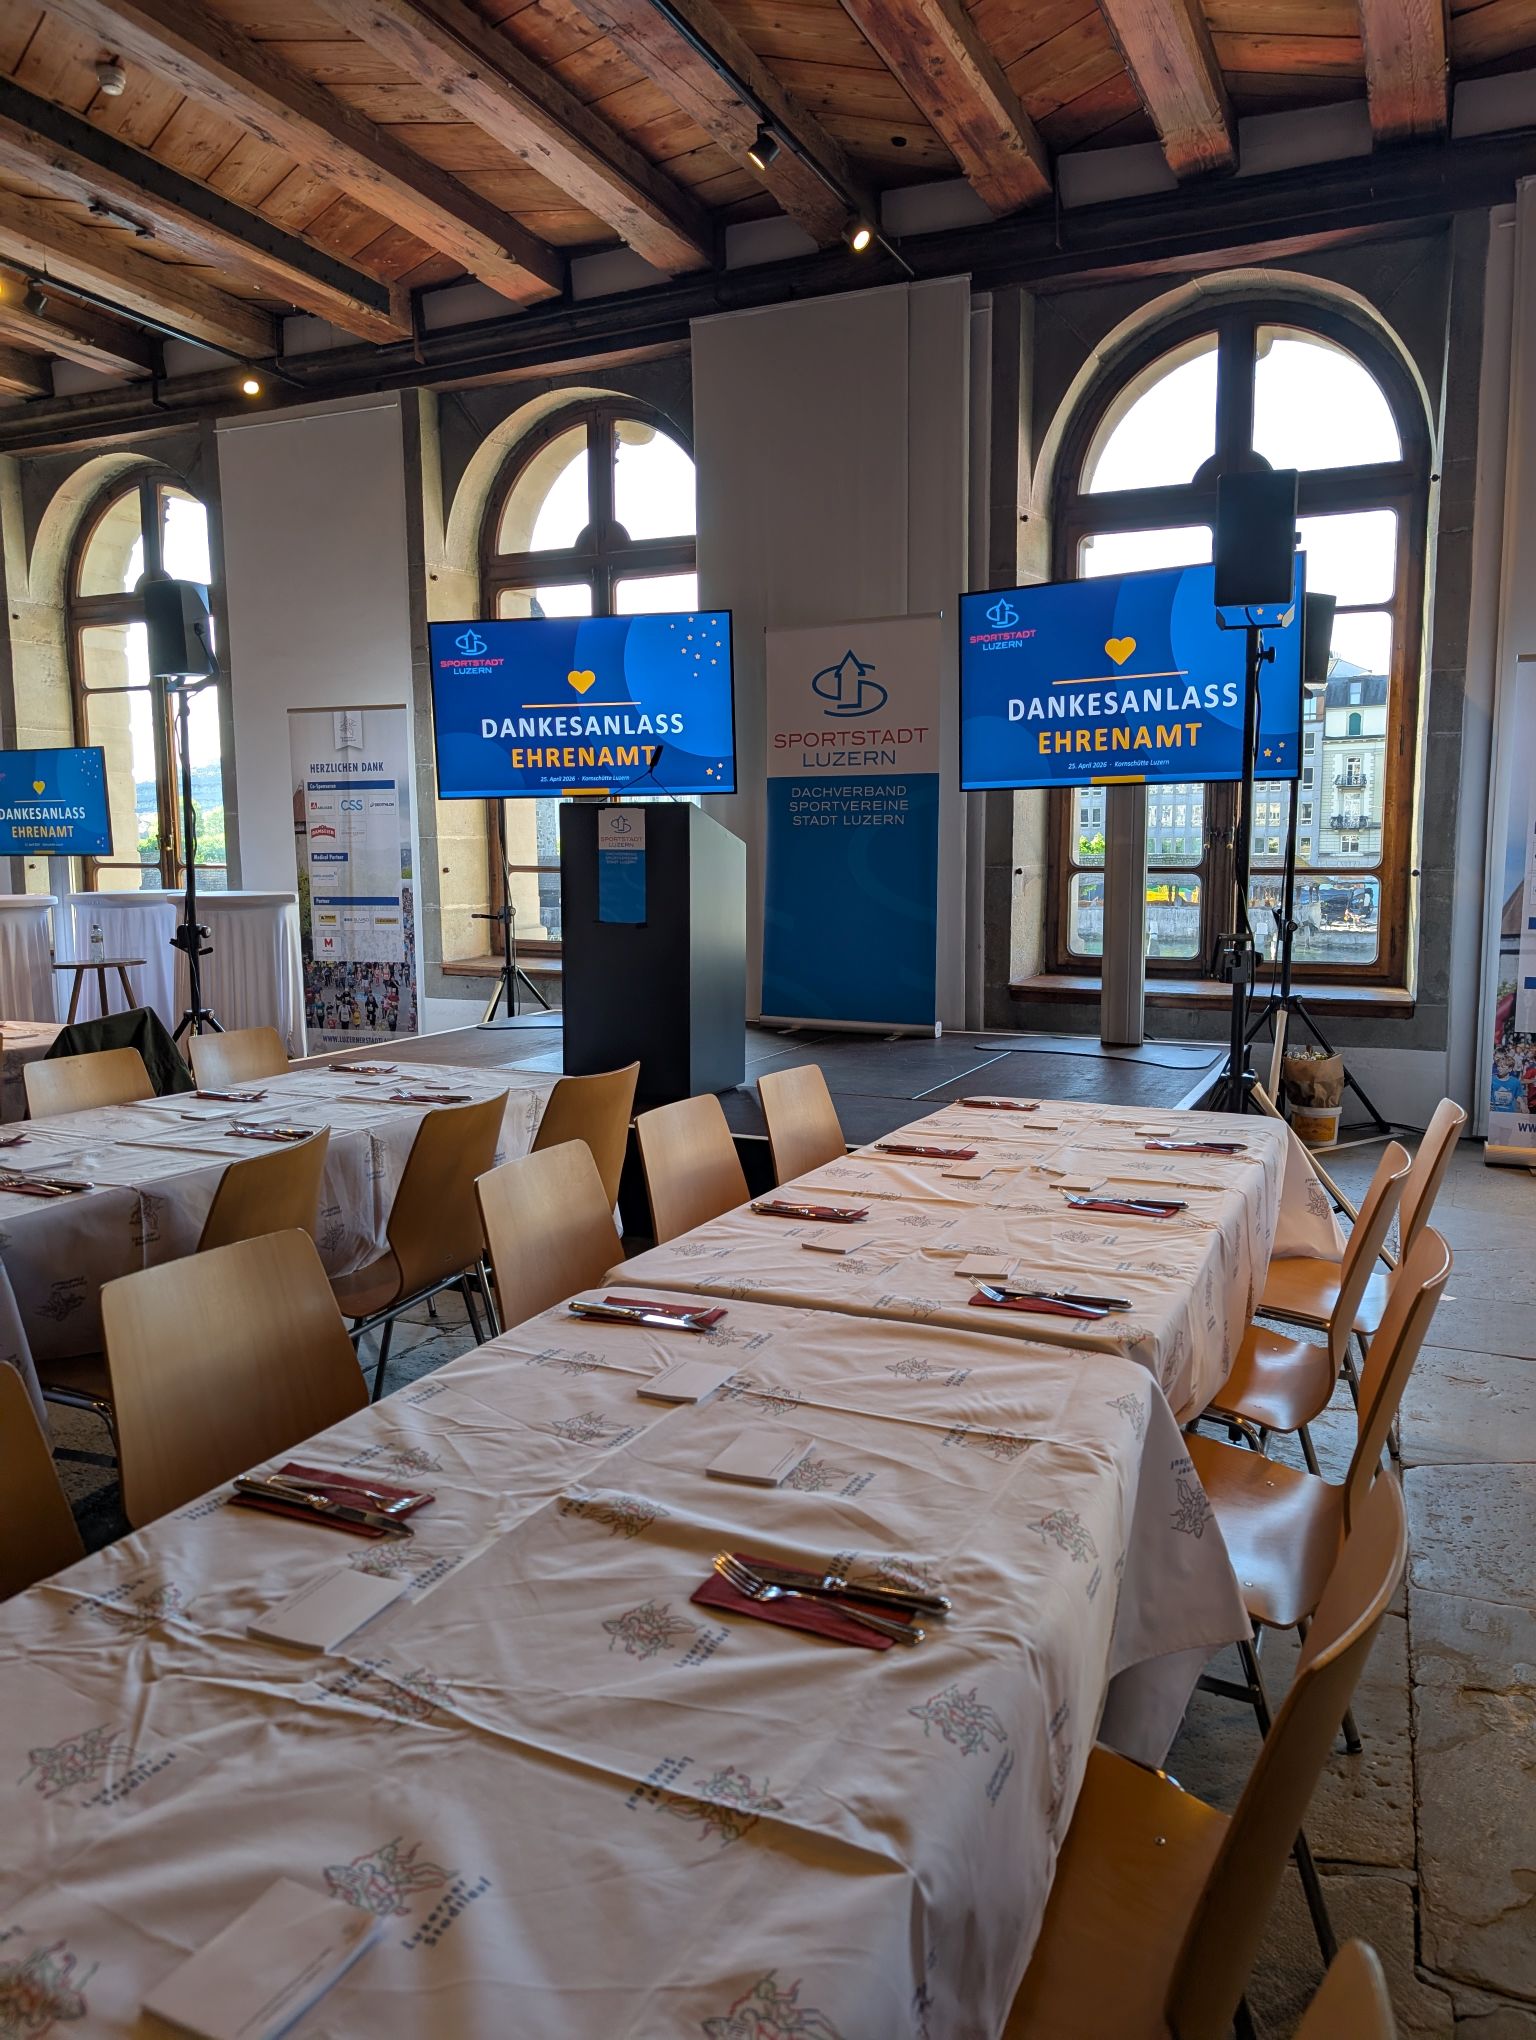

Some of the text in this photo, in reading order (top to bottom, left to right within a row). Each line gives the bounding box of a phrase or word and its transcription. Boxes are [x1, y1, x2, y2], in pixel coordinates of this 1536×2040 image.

[969, 629, 1037, 644] SPORTSTADT
[982, 640, 1023, 651] LUZERN
[440, 658, 504, 668] SPORTSTADT
[453, 667, 493, 675] LUZERN
[1008, 682, 1239, 721] DANKESANLASS
[481, 713, 685, 739] DANKESANLASS
[774, 728, 929, 749] SPORTSTADT
[1038, 722, 1203, 755] EHRENAMT
[511, 745, 656, 769] EHRENAMT
[802, 750, 897, 768] LUZERN
[310, 761, 384, 774] HERZLICHEN DANK
[1078, 762, 1092, 770] April
[791, 785, 907, 798] DACHVERBAND
[340, 800, 363, 811] CSS
[789, 800, 909, 812] SPORTVEREINE
[0, 807, 86, 820] DANKESANLASS
[792, 814, 905, 826] STADT LUZERN
[12, 825, 74, 838] EHRENAMT
